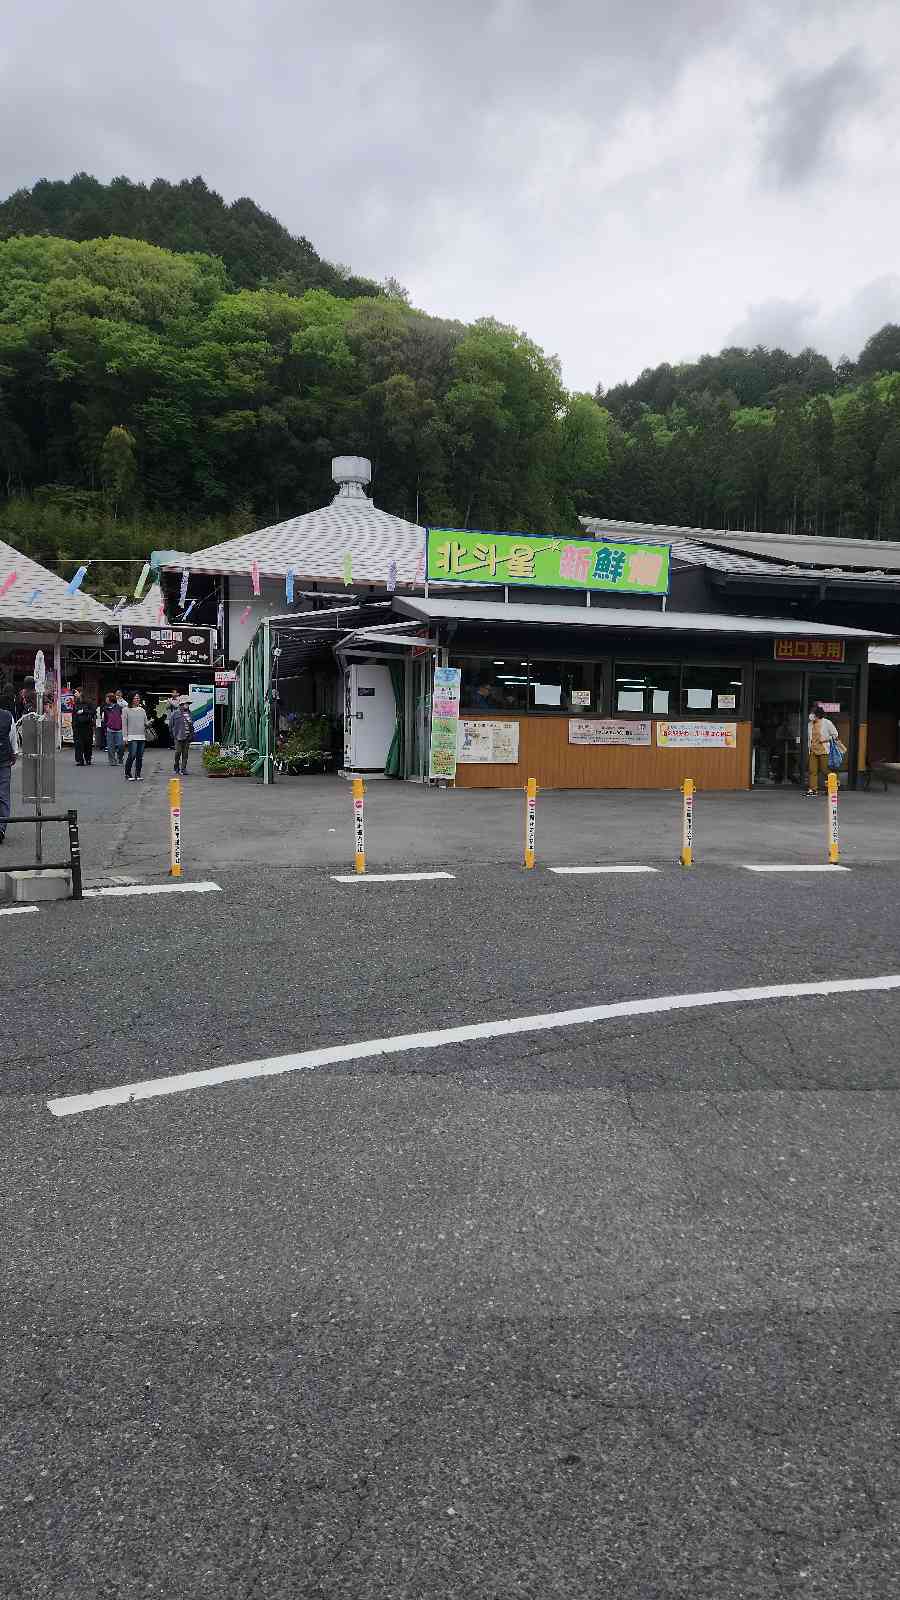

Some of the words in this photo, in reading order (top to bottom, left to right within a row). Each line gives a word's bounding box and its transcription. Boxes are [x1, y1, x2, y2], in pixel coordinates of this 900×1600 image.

[438, 541, 537, 578] 北斗星
[777, 640, 841, 657] 出口専用
